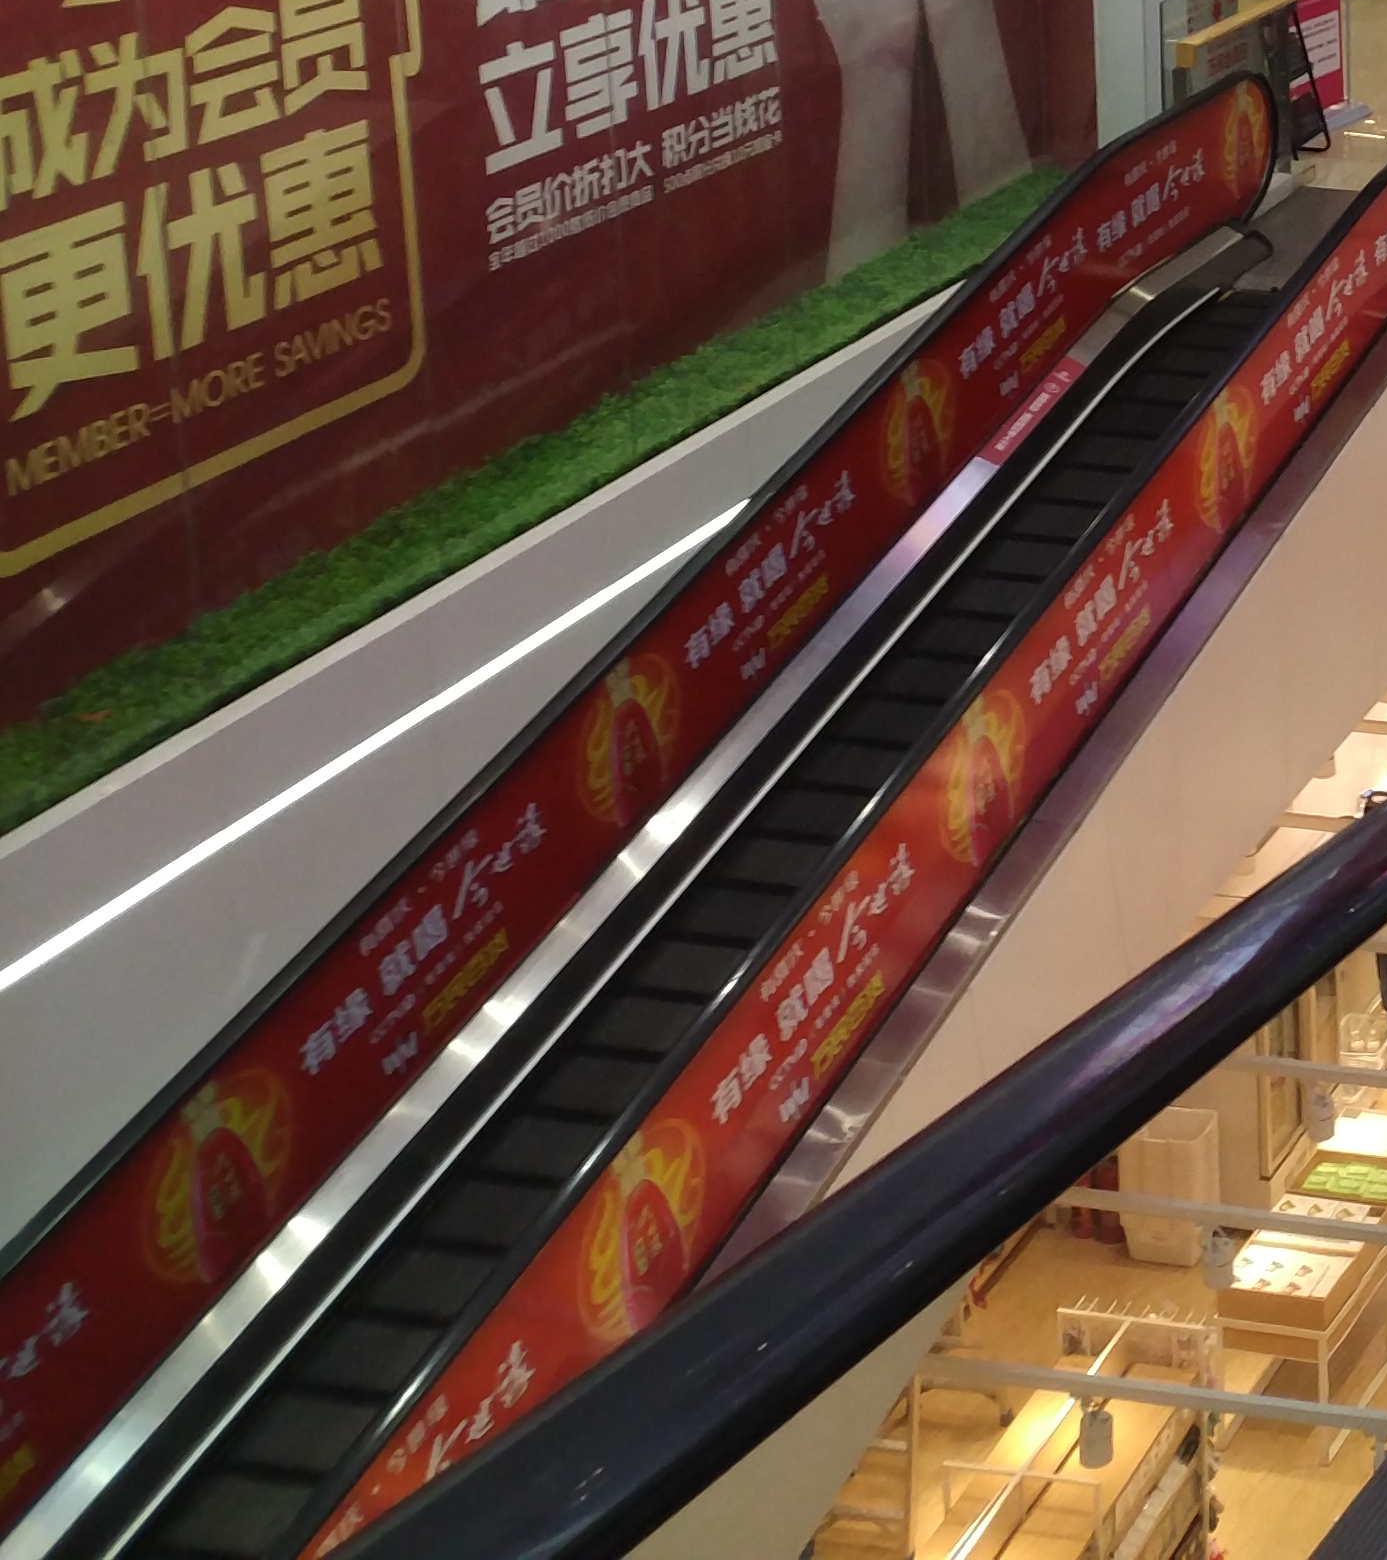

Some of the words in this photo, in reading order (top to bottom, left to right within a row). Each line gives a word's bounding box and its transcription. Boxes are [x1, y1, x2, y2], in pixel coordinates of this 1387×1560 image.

[661, 86, 782, 169] 积分当钱花
[485, 141, 655, 244] 会员价折扣大
[0, 119, 384, 422] 更优惠
[273, 297, 393, 378] SAVINGS
